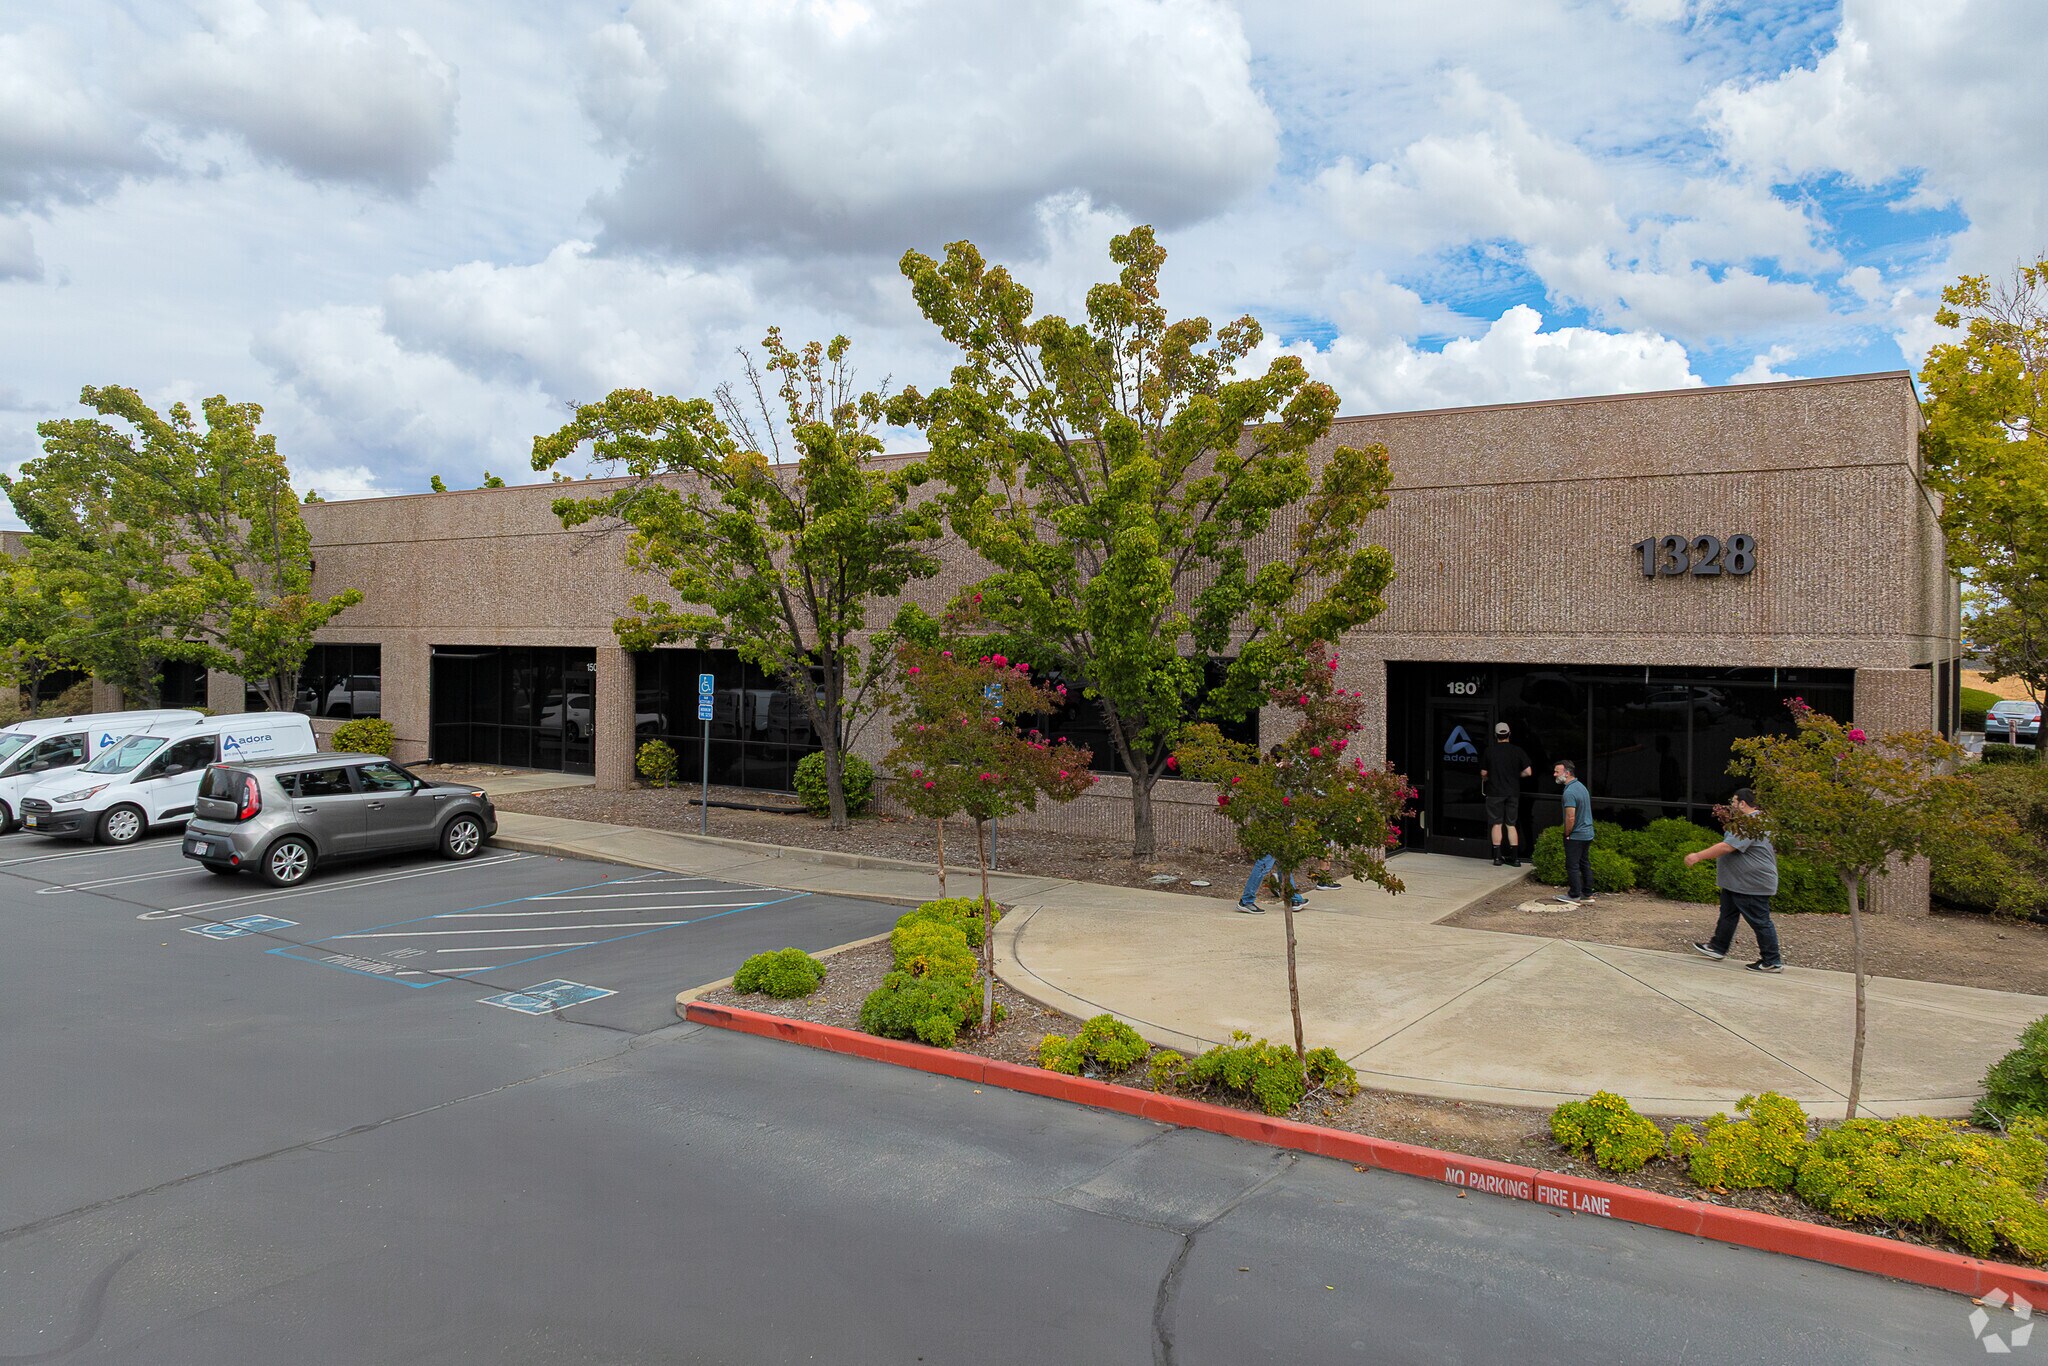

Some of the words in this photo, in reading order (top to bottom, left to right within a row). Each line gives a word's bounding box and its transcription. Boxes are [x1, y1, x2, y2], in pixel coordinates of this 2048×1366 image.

[1632, 533, 1757, 576] 1328
[586, 662, 597, 672] 150
[1447, 682, 1477, 695] 180
[238, 734, 273, 745] adora
[1443, 754, 1478, 763] adora
[1445, 1167, 1465, 1186] NO
[1469, 1172, 1529, 1199] PARKING
[1537, 1184, 1568, 1207] FIRE
[1573, 1191, 1611, 1217] LANE
